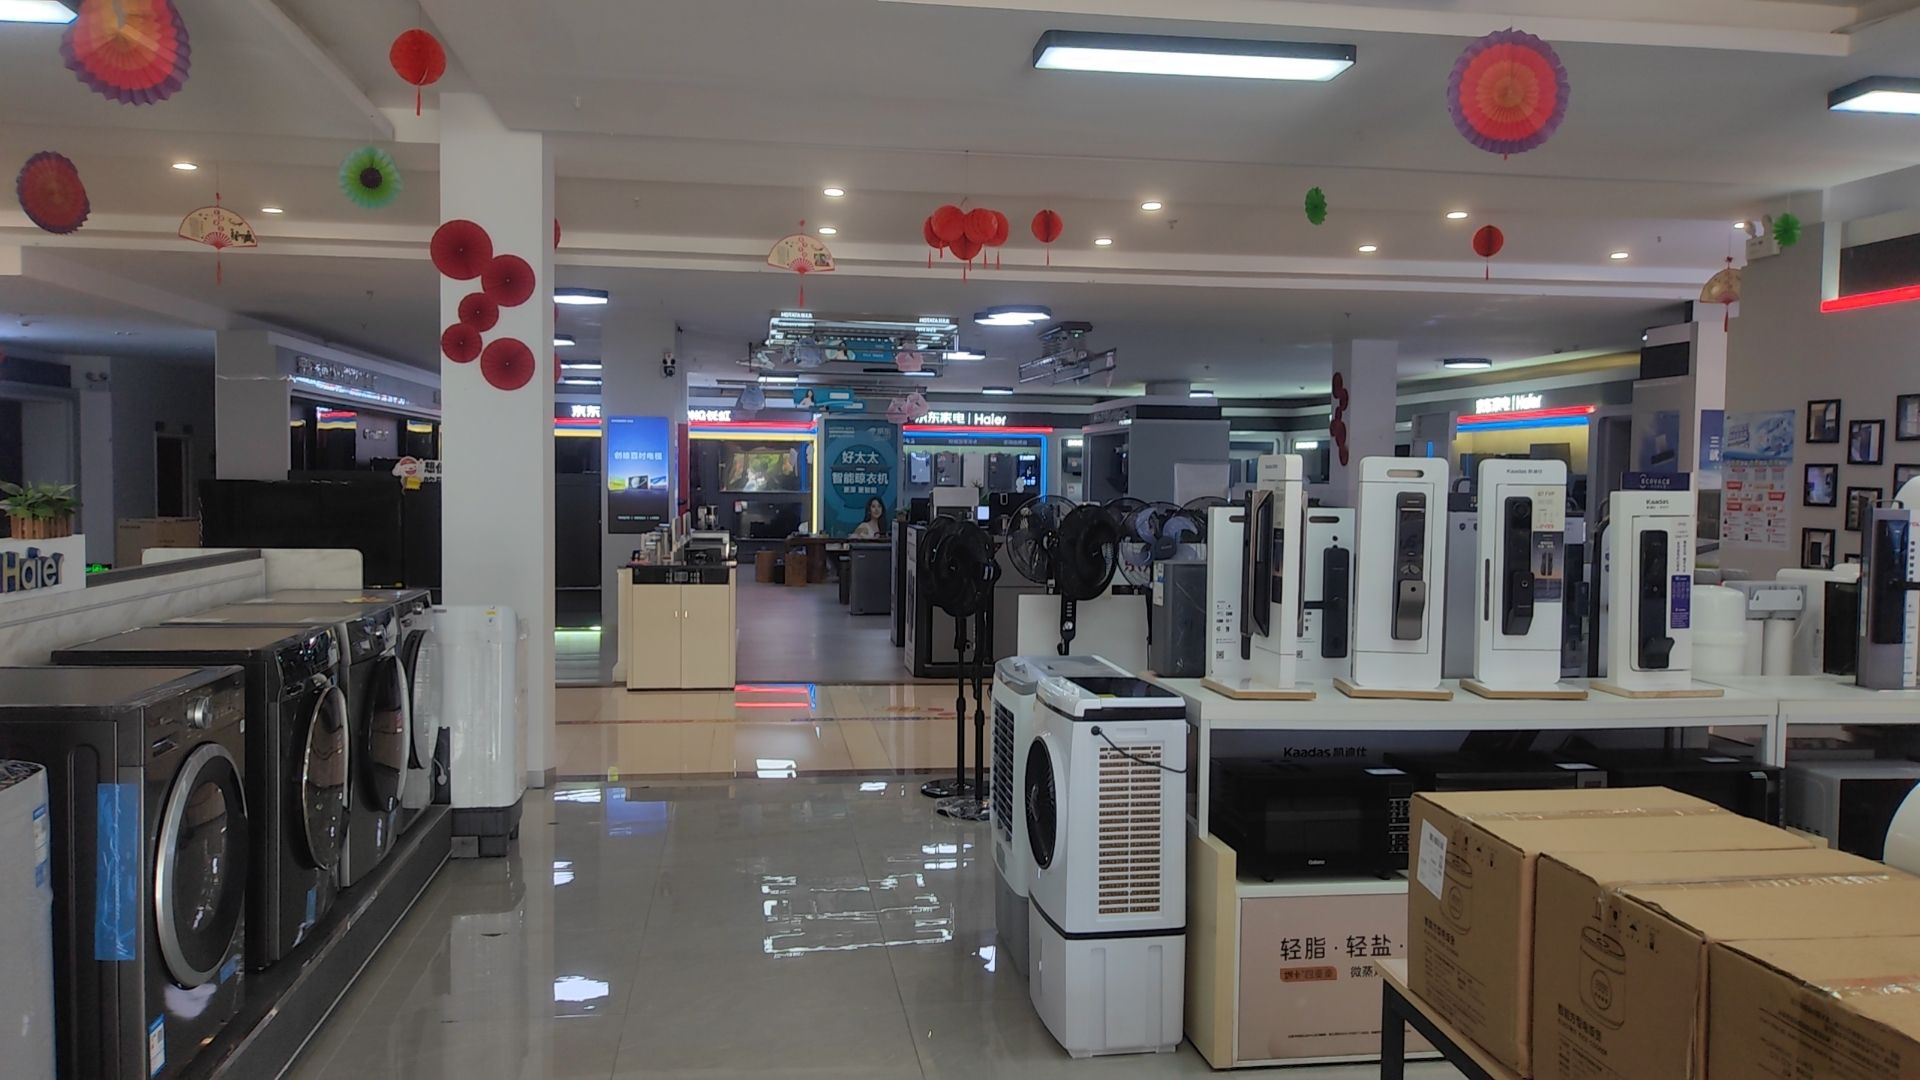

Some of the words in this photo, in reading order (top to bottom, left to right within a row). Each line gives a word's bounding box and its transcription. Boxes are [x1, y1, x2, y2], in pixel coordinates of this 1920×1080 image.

[974, 412, 1007, 426] Haier
[841, 450, 880, 465] 好太太
[831, 471, 890, 485] 智能晾衣机
[0, 547, 64, 593] Haier
[1283, 747, 1332, 758] Kaadas
[1351, 965, 1379, 978] 微蒸
